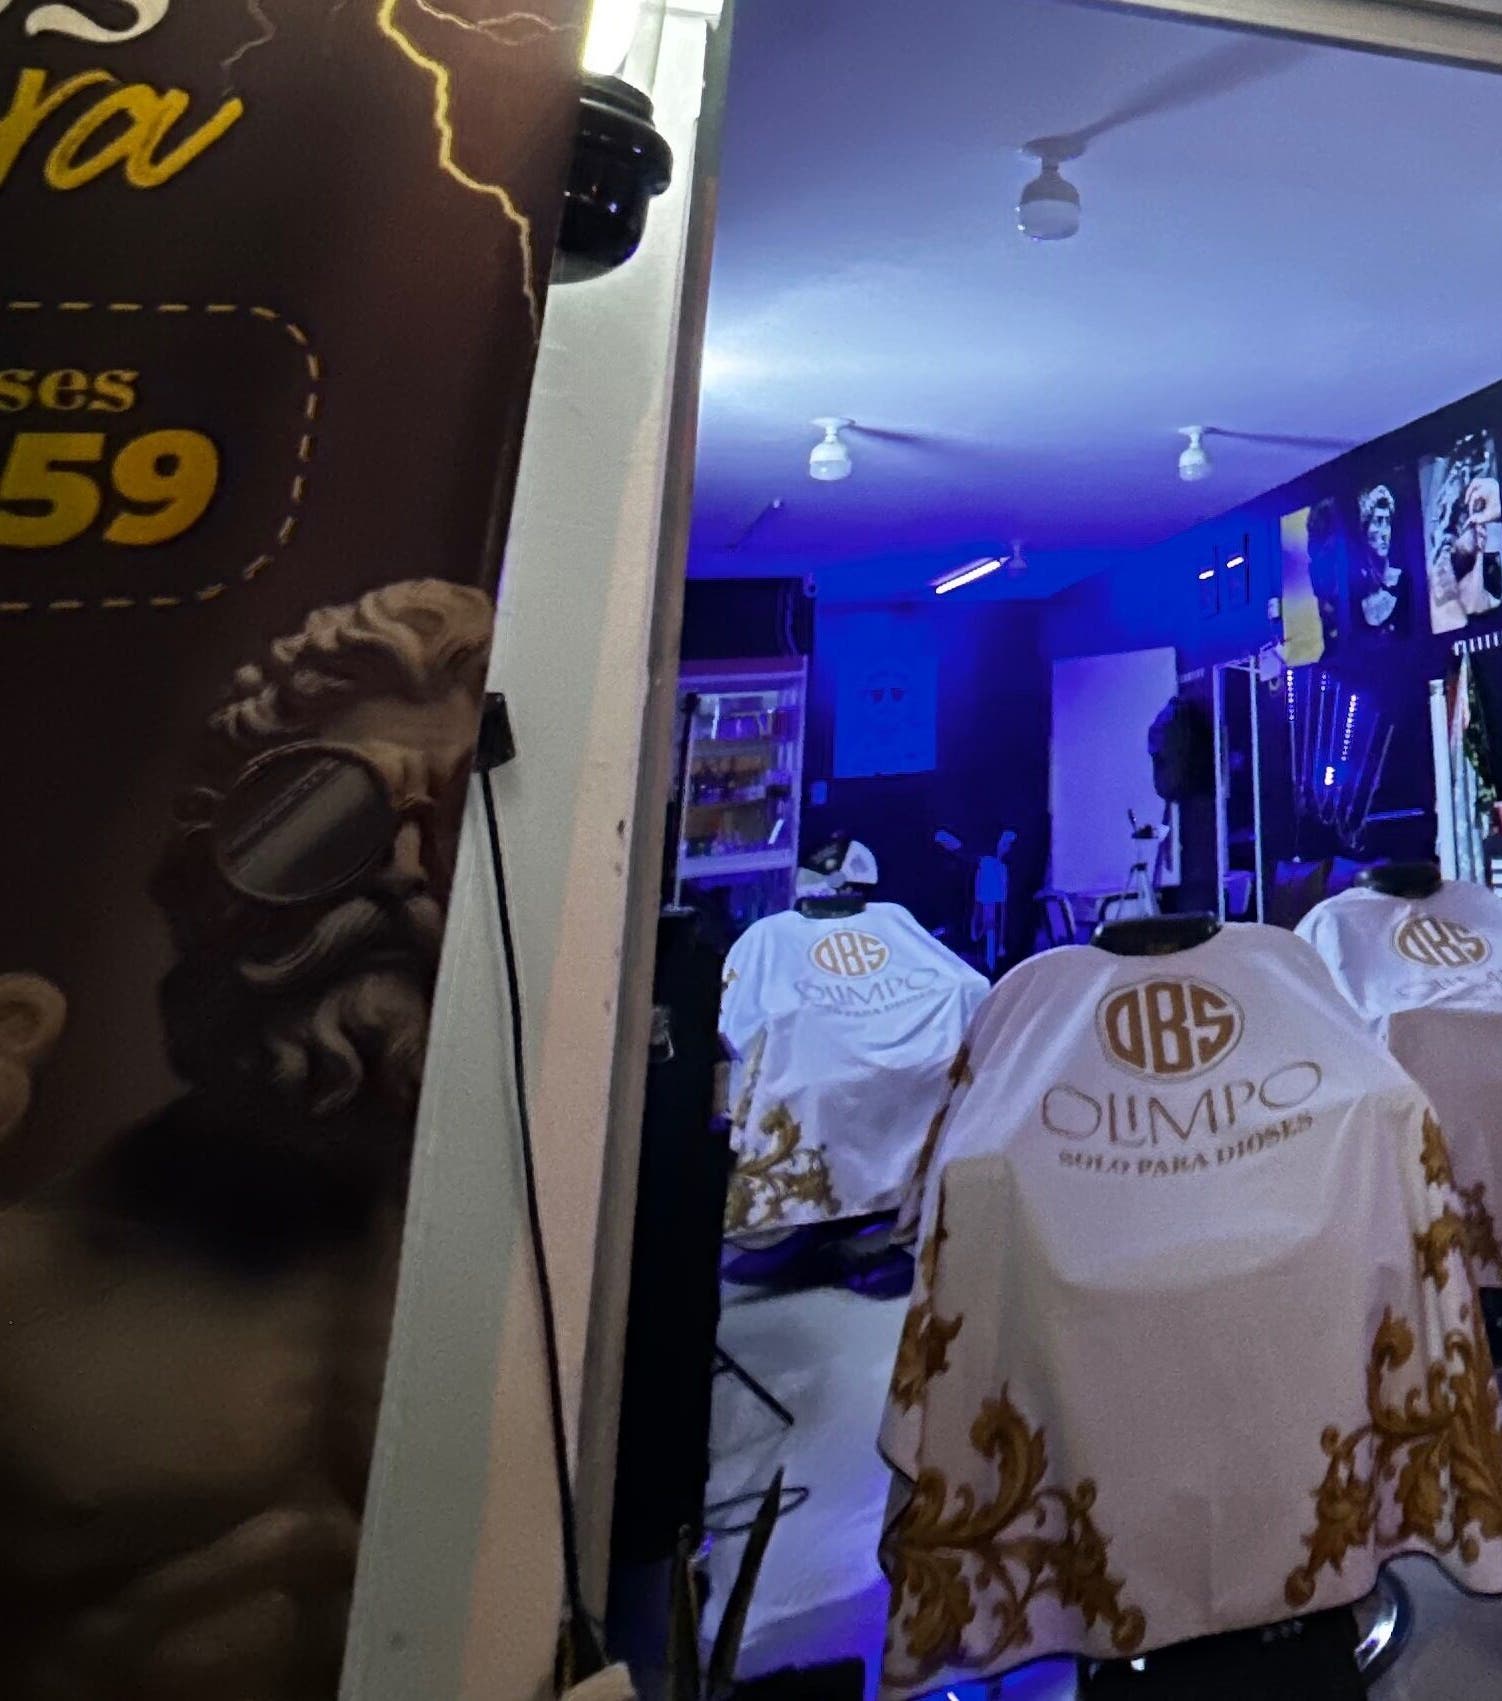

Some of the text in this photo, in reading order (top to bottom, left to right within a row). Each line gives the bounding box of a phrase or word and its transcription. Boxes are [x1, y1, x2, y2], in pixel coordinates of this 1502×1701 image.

[0, 428, 219, 548] 59
[1042, 1061, 1322, 1148] OLIMPO
[1059, 1111, 1313, 1178] SOLO PARA DIOSES
